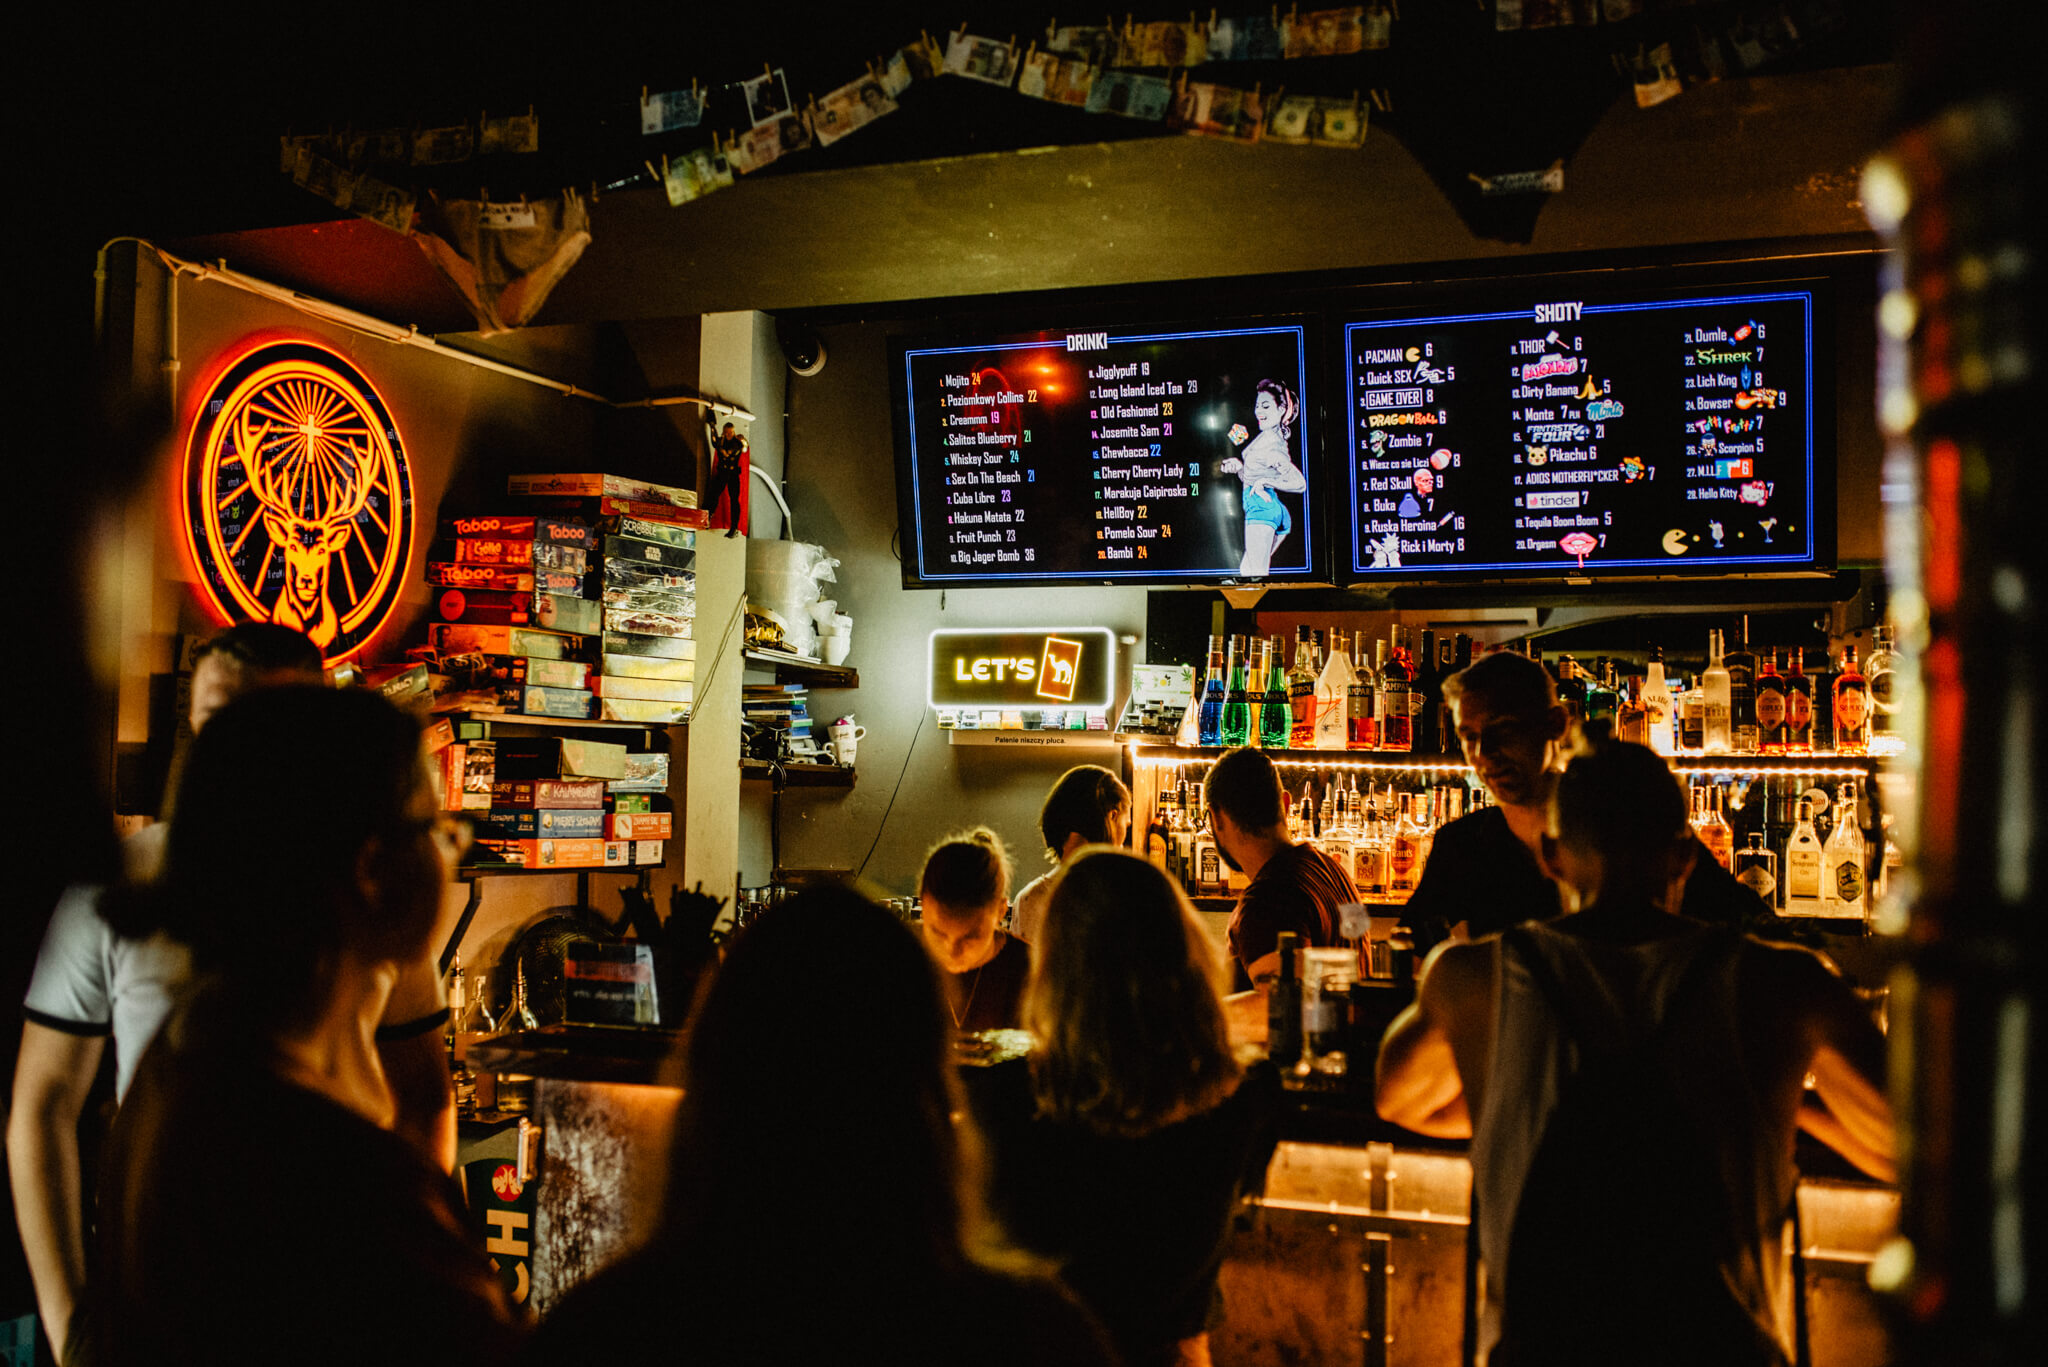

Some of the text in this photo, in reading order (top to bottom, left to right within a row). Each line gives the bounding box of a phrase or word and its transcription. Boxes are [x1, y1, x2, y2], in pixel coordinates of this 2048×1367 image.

[1535, 302, 1583, 323] SHOTY
[1066, 332, 1108, 352] DRINKI
[1695, 324, 1765, 343] Dumle 6
[1365, 343, 1433, 364] PACMAN 6
[1519, 336, 1582, 355] THOR 6
[1756, 347, 1764, 362] 7
[1096, 362, 1150, 380] Jigglypuff 19
[1580, 358, 1588, 373] 7
[945, 372, 981, 388] Mojito 24
[1367, 366, 1455, 386] Quick SEX 5
[1696, 371, 1763, 388] Lich King 8
[1098, 380, 1198, 400] Long Island Iced Tea 29
[1521, 379, 1611, 399] Dirty Banana 5
[947, 390, 1038, 407] Poziomkowy Collins 22
[1369, 389, 1434, 407] GAME OVER 8
[1696, 390, 1787, 410] Bowser 9
[950, 411, 1000, 426] Creammm 19
[1101, 402, 1173, 419] Old Fashioned 23
[1438, 410, 1446, 424] 6
[1525, 407, 1555, 421] Monte
[1560, 404, 1568, 419] 7
[1100, 422, 1173, 439] Josemite Sam 21
[1526, 423, 1605, 439] FANTASTIC 21
[1696, 415, 1764, 434] Tutti Frutti 7
[949, 430, 1032, 446] Salitos Blueberry 21
[1388, 432, 1433, 448] Zombie 7
[1532, 431, 1572, 443] FOUR
[1101, 444, 1161, 459] Chewbacca 22
[1550, 445, 1597, 462] Pikachu 6
[1718, 437, 1764, 455] Scorpion 5
[950, 450, 1020, 466] Whiskey Sour 24
[1453, 453, 1461, 467] 8
[1101, 462, 1200, 481] Cherry Cherry Lady 20
[1525, 471, 1551, 485] ADIOS
[1648, 465, 1656, 480] 7
[1741, 461, 1749, 475] 6
[951, 469, 1036, 485] Sex On The Beach 21
[1370, 475, 1444, 491] Red Skull 9
[953, 490, 1011, 504] Cuba Libre 23
[1104, 483, 1199, 501] Marakuja Caipiroska 21
[1540, 491, 1589, 507] tinder 7
[1698, 482, 1774, 500] Hello Kitty 7
[1103, 505, 1148, 521] HellBoy 22
[1373, 498, 1434, 512] Buka 7
[954, 509, 1025, 524] Hakuna Matata 22
[1371, 516, 1465, 534] Ruska Heroina 16
[1525, 511, 1612, 529] Tequila Boom Boom 5
[453, 518, 500, 535] Taboo
[547, 524, 585, 540] Taboo
[623, 519, 657, 537] SCRABBLE
[1104, 524, 1172, 540] Pomelo Sour 24
[956, 529, 1016, 543] Fruit Punch 23
[1526, 533, 1607, 551] Orgasm 7
[1107, 545, 1148, 559] Bambi 24
[1400, 538, 1465, 554] Rick i Morty 8
[958, 548, 1035, 565] Big Jager Bomb 36
[443, 566, 495, 582] Taboo
[545, 574, 577, 589] Taboo
[956, 657, 1036, 681] LET'S
[995, 736, 1019, 744] Palenie
[1020, 737, 1045, 745] niszczy
